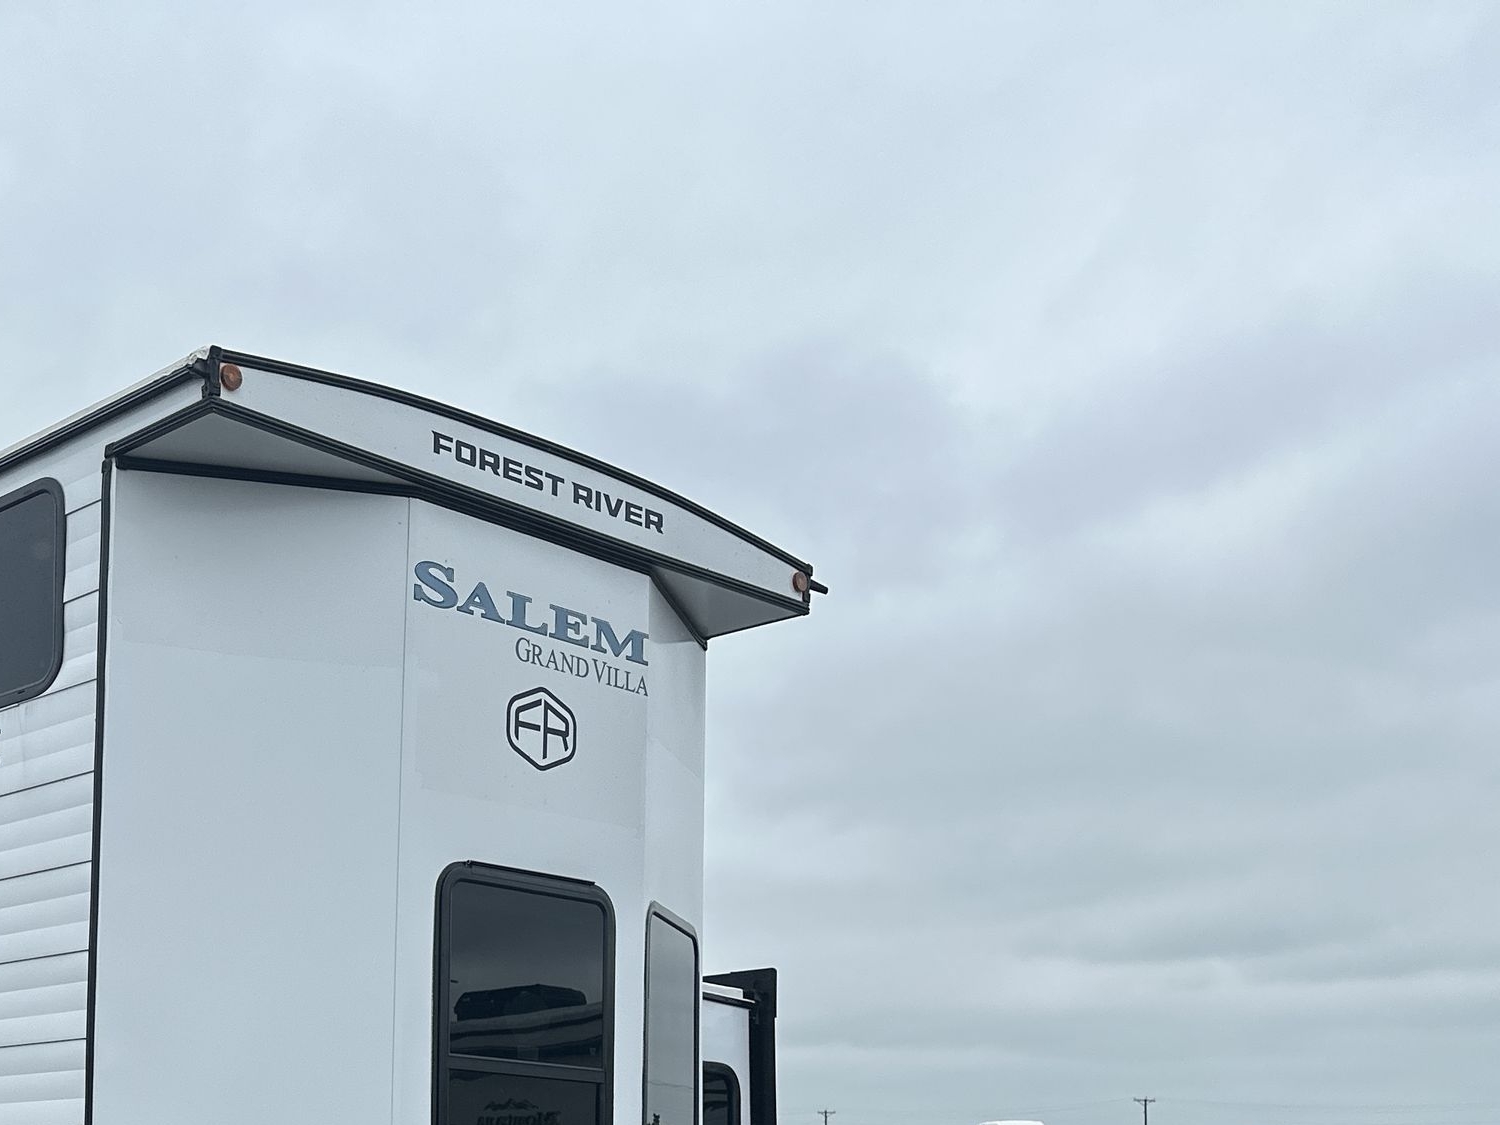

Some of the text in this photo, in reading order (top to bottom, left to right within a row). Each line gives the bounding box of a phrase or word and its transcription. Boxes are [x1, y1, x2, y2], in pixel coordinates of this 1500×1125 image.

[431, 430, 664, 534] FOREST RIVER
[413, 561, 650, 666] SALEM
[515, 637, 649, 697] GRAND VILLA
